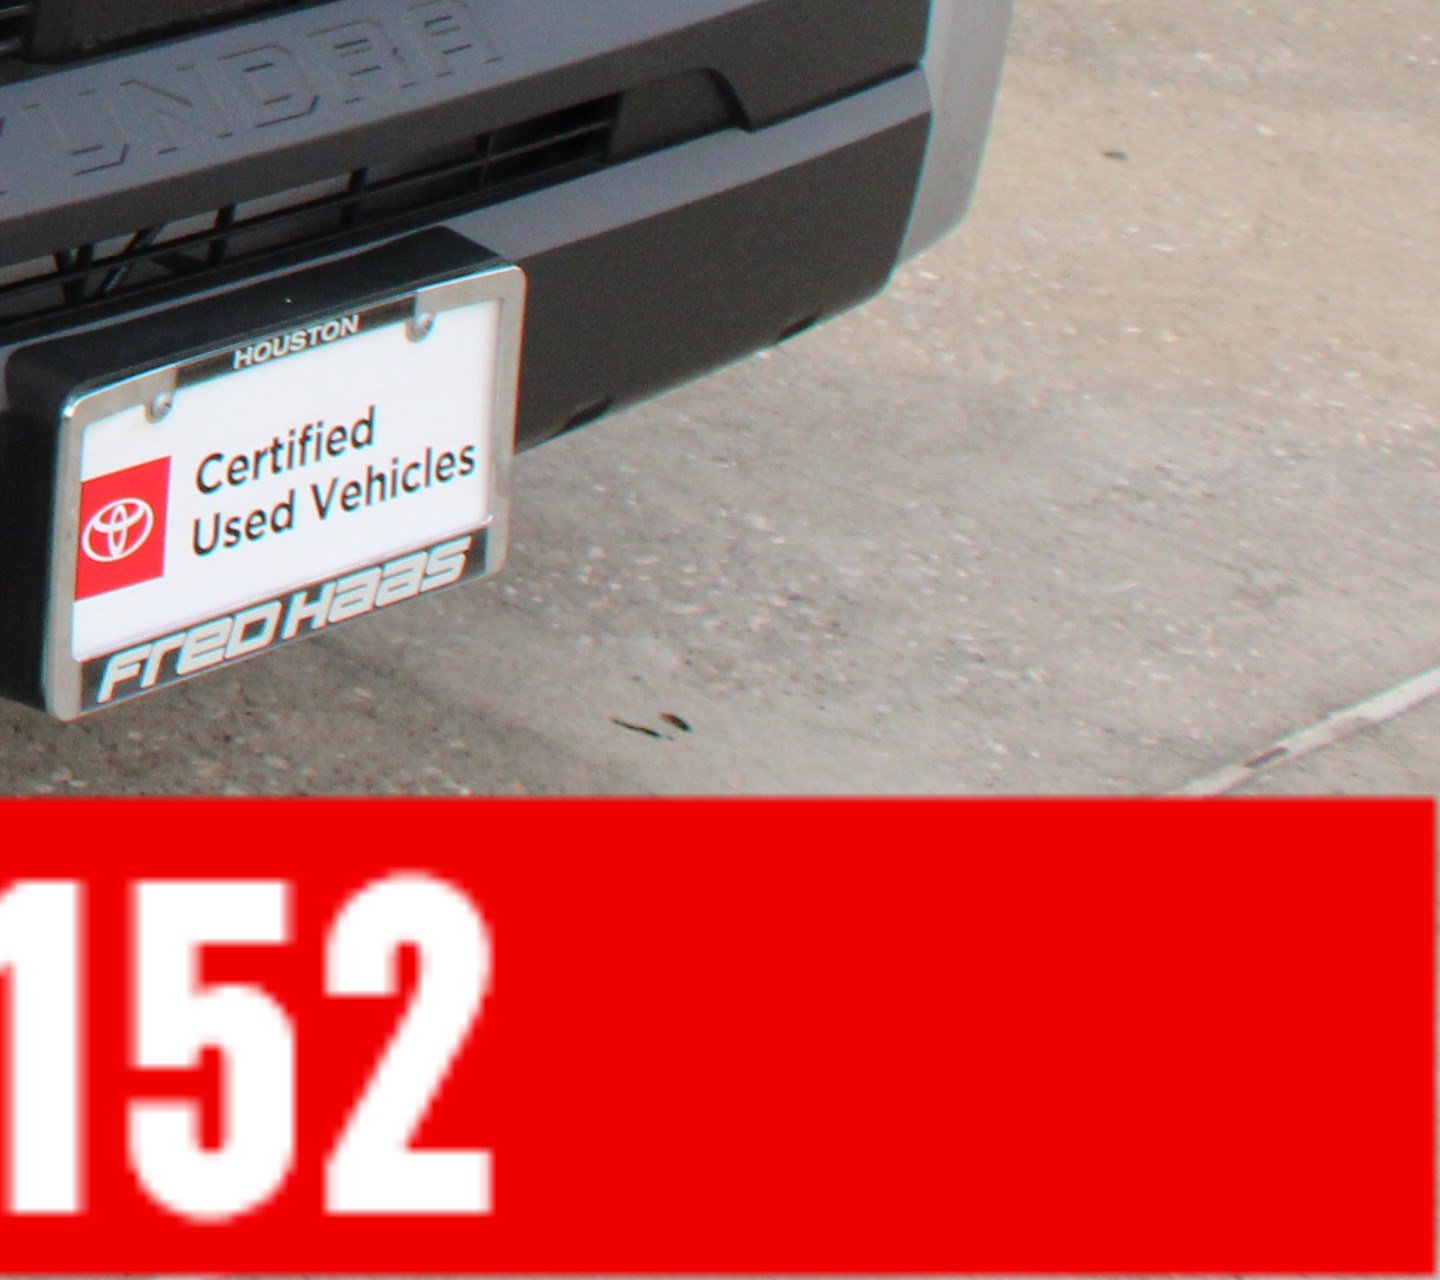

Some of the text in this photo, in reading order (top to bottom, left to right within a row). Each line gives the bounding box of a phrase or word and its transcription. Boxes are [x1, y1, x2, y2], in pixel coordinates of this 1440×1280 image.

[232, 315, 360, 370] HOUSTON
[195, 405, 376, 494] Certified
[192, 444, 476, 555] Used Vehicles
